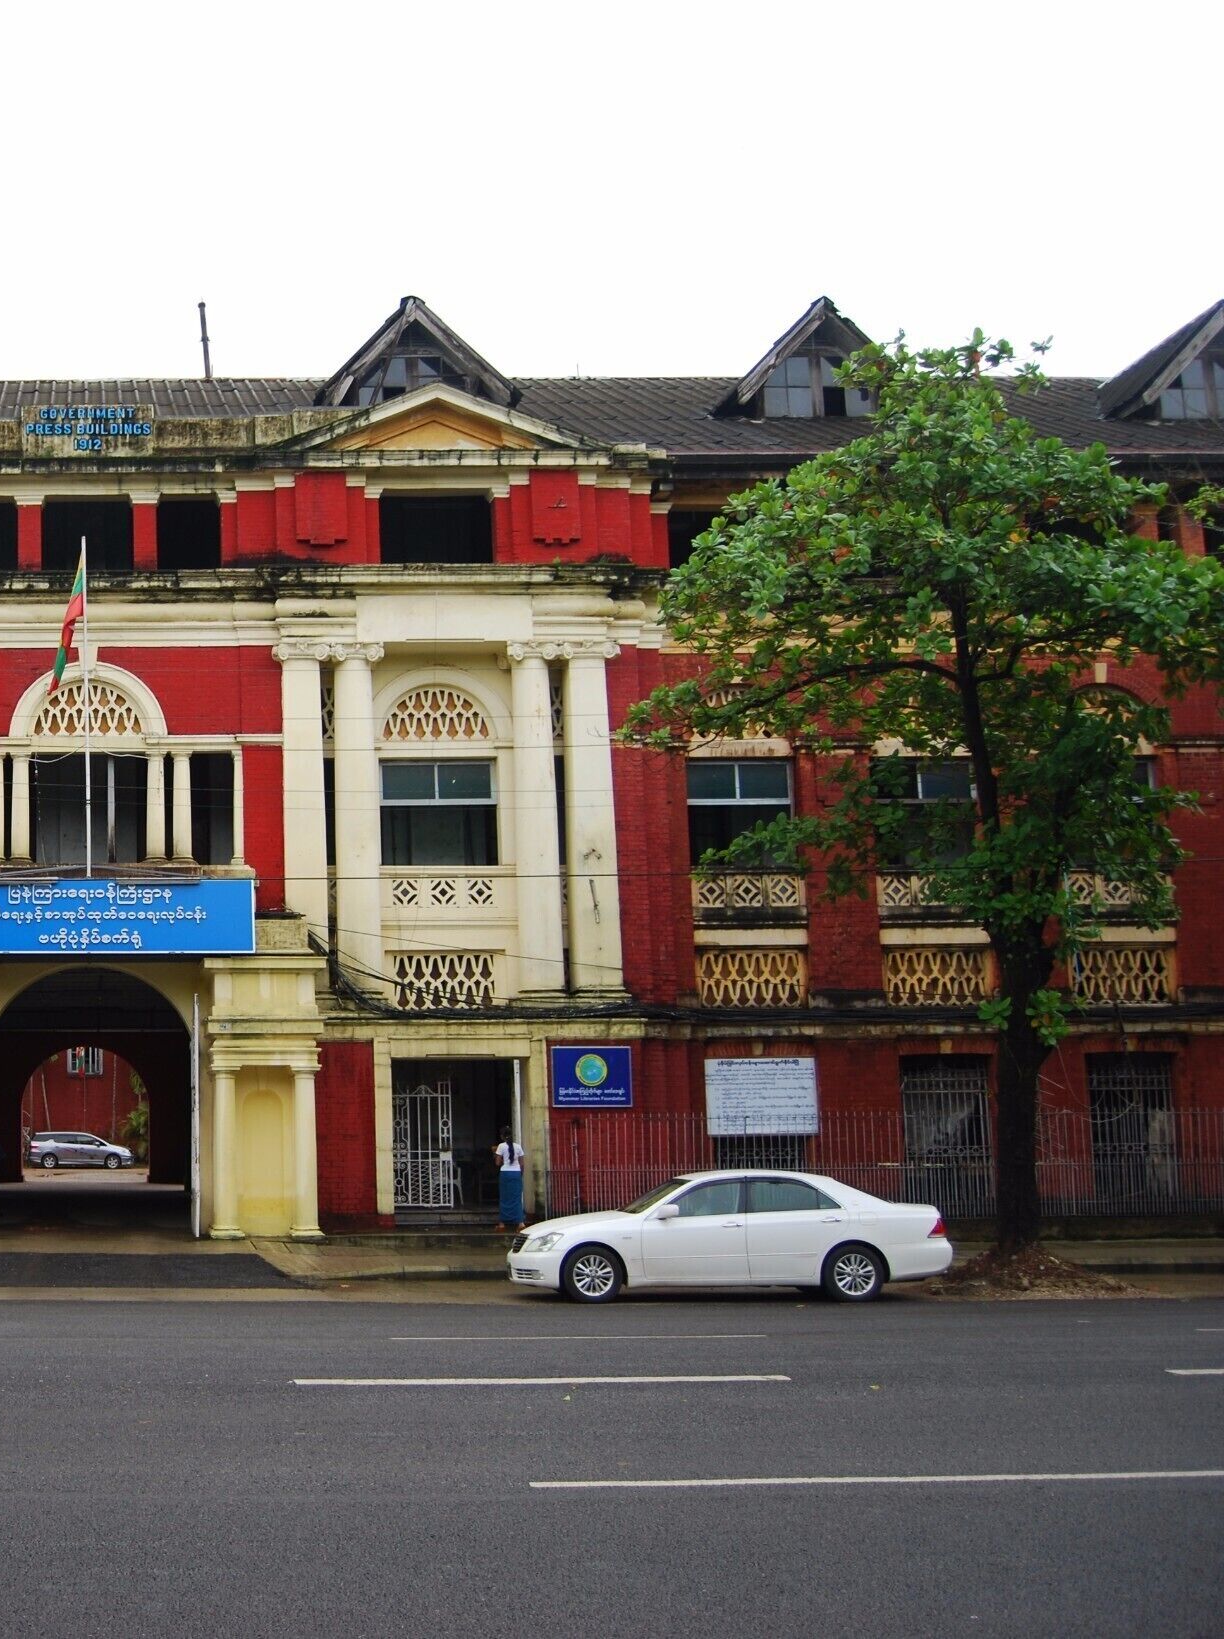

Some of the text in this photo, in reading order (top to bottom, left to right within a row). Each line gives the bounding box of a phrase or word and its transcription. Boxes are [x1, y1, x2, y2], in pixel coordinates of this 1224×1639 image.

[39, 408, 135, 420] GOVERNMENT
[25, 423, 152, 435] PRESS BUILDINGS
[73, 438, 102, 450] 1912
